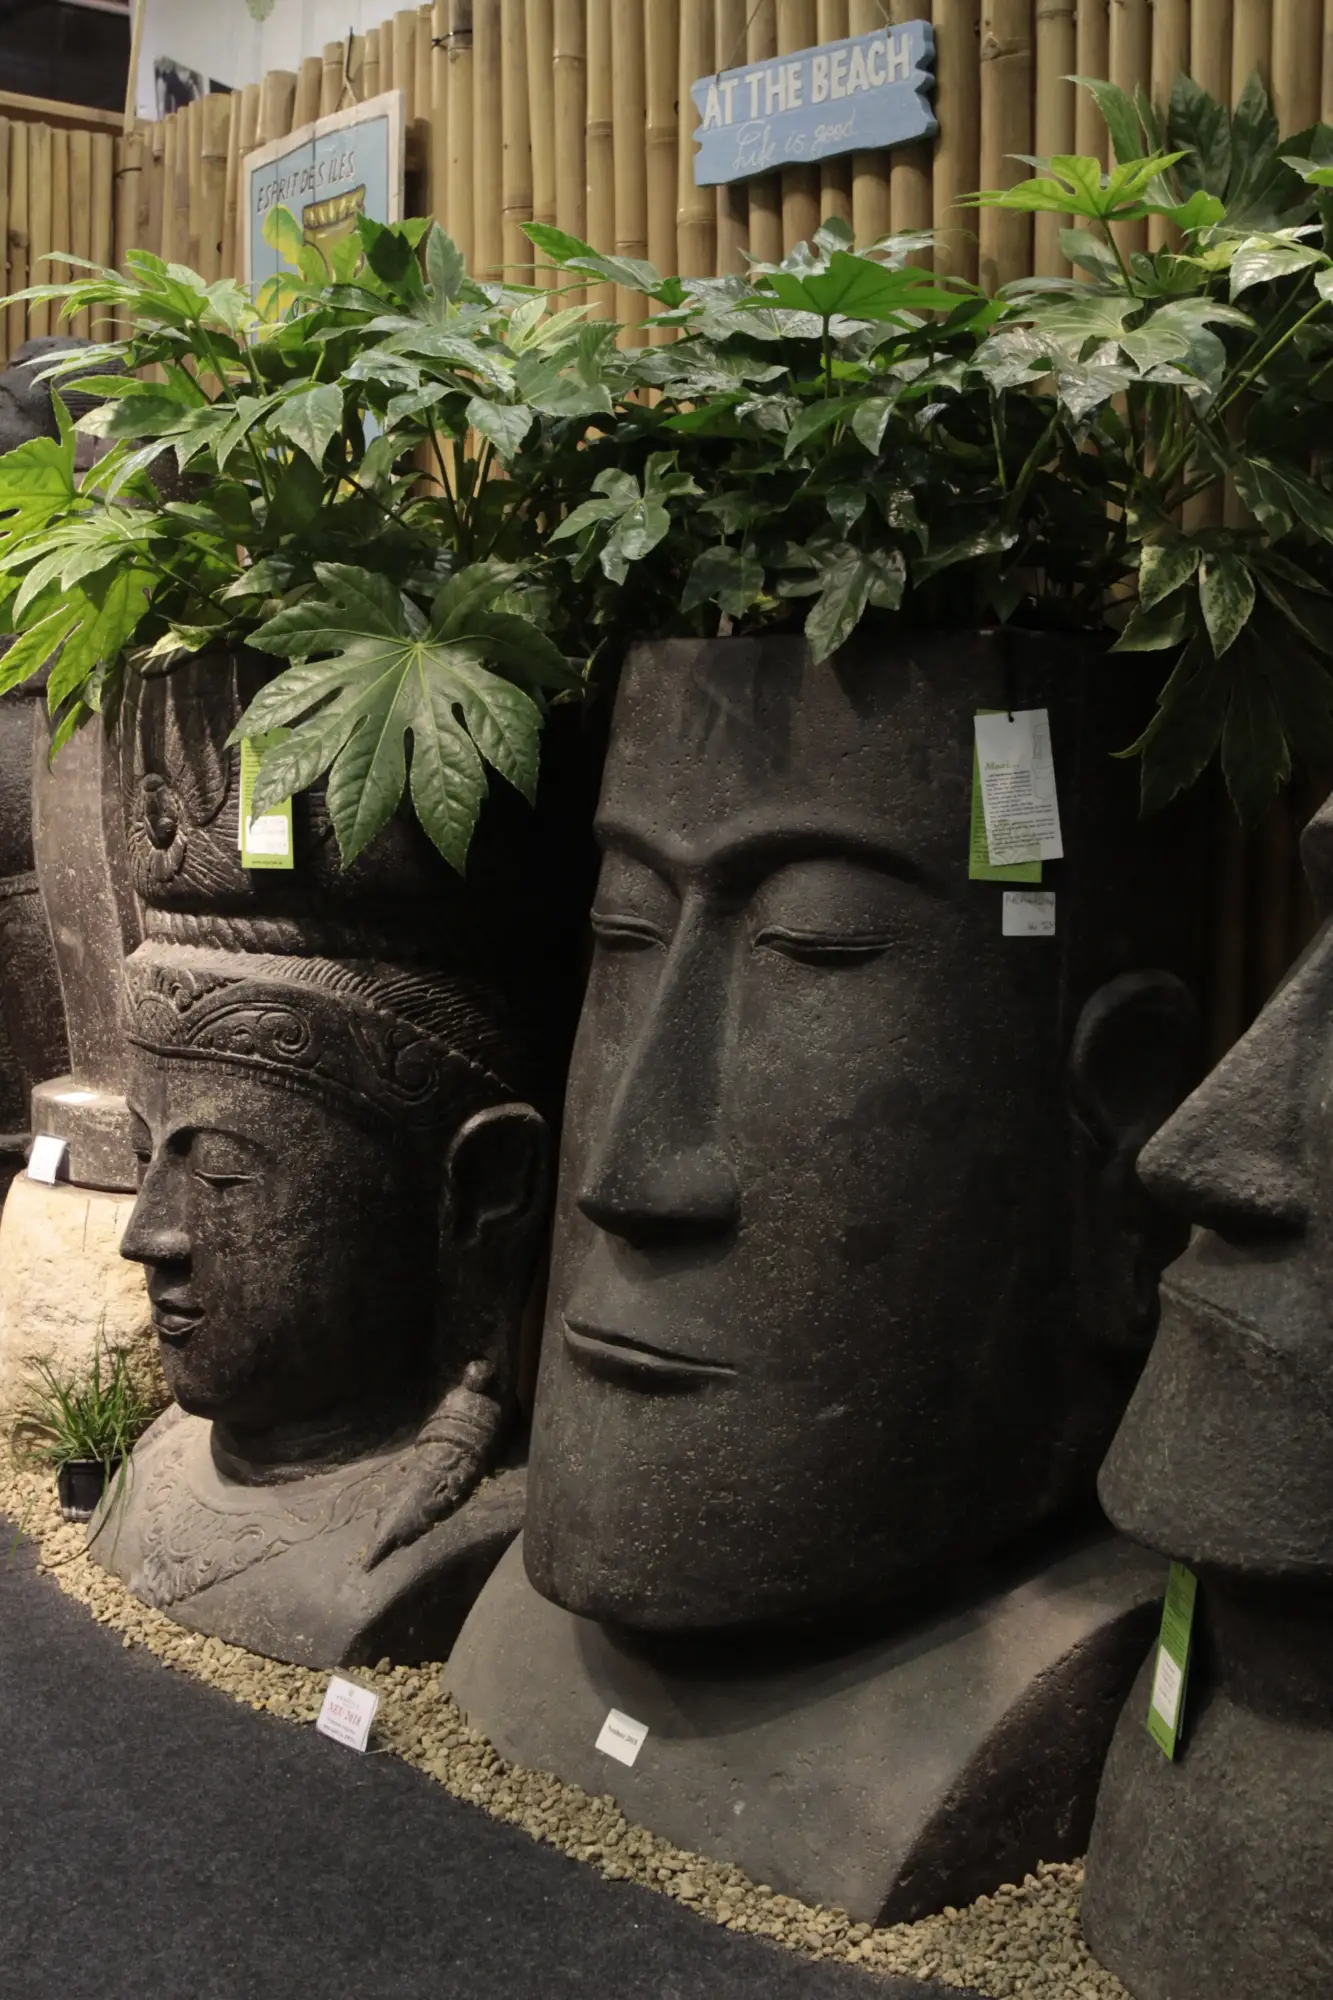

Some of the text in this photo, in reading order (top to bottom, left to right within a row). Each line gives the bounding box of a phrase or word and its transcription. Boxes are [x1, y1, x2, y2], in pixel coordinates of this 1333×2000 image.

[703, 33, 912, 131] AT THE BEACH
[785, 134, 805, 154] is
[811, 108, 855, 157] good
[256, 171, 301, 215] ESPRIT
[300, 160, 325, 196] DES
